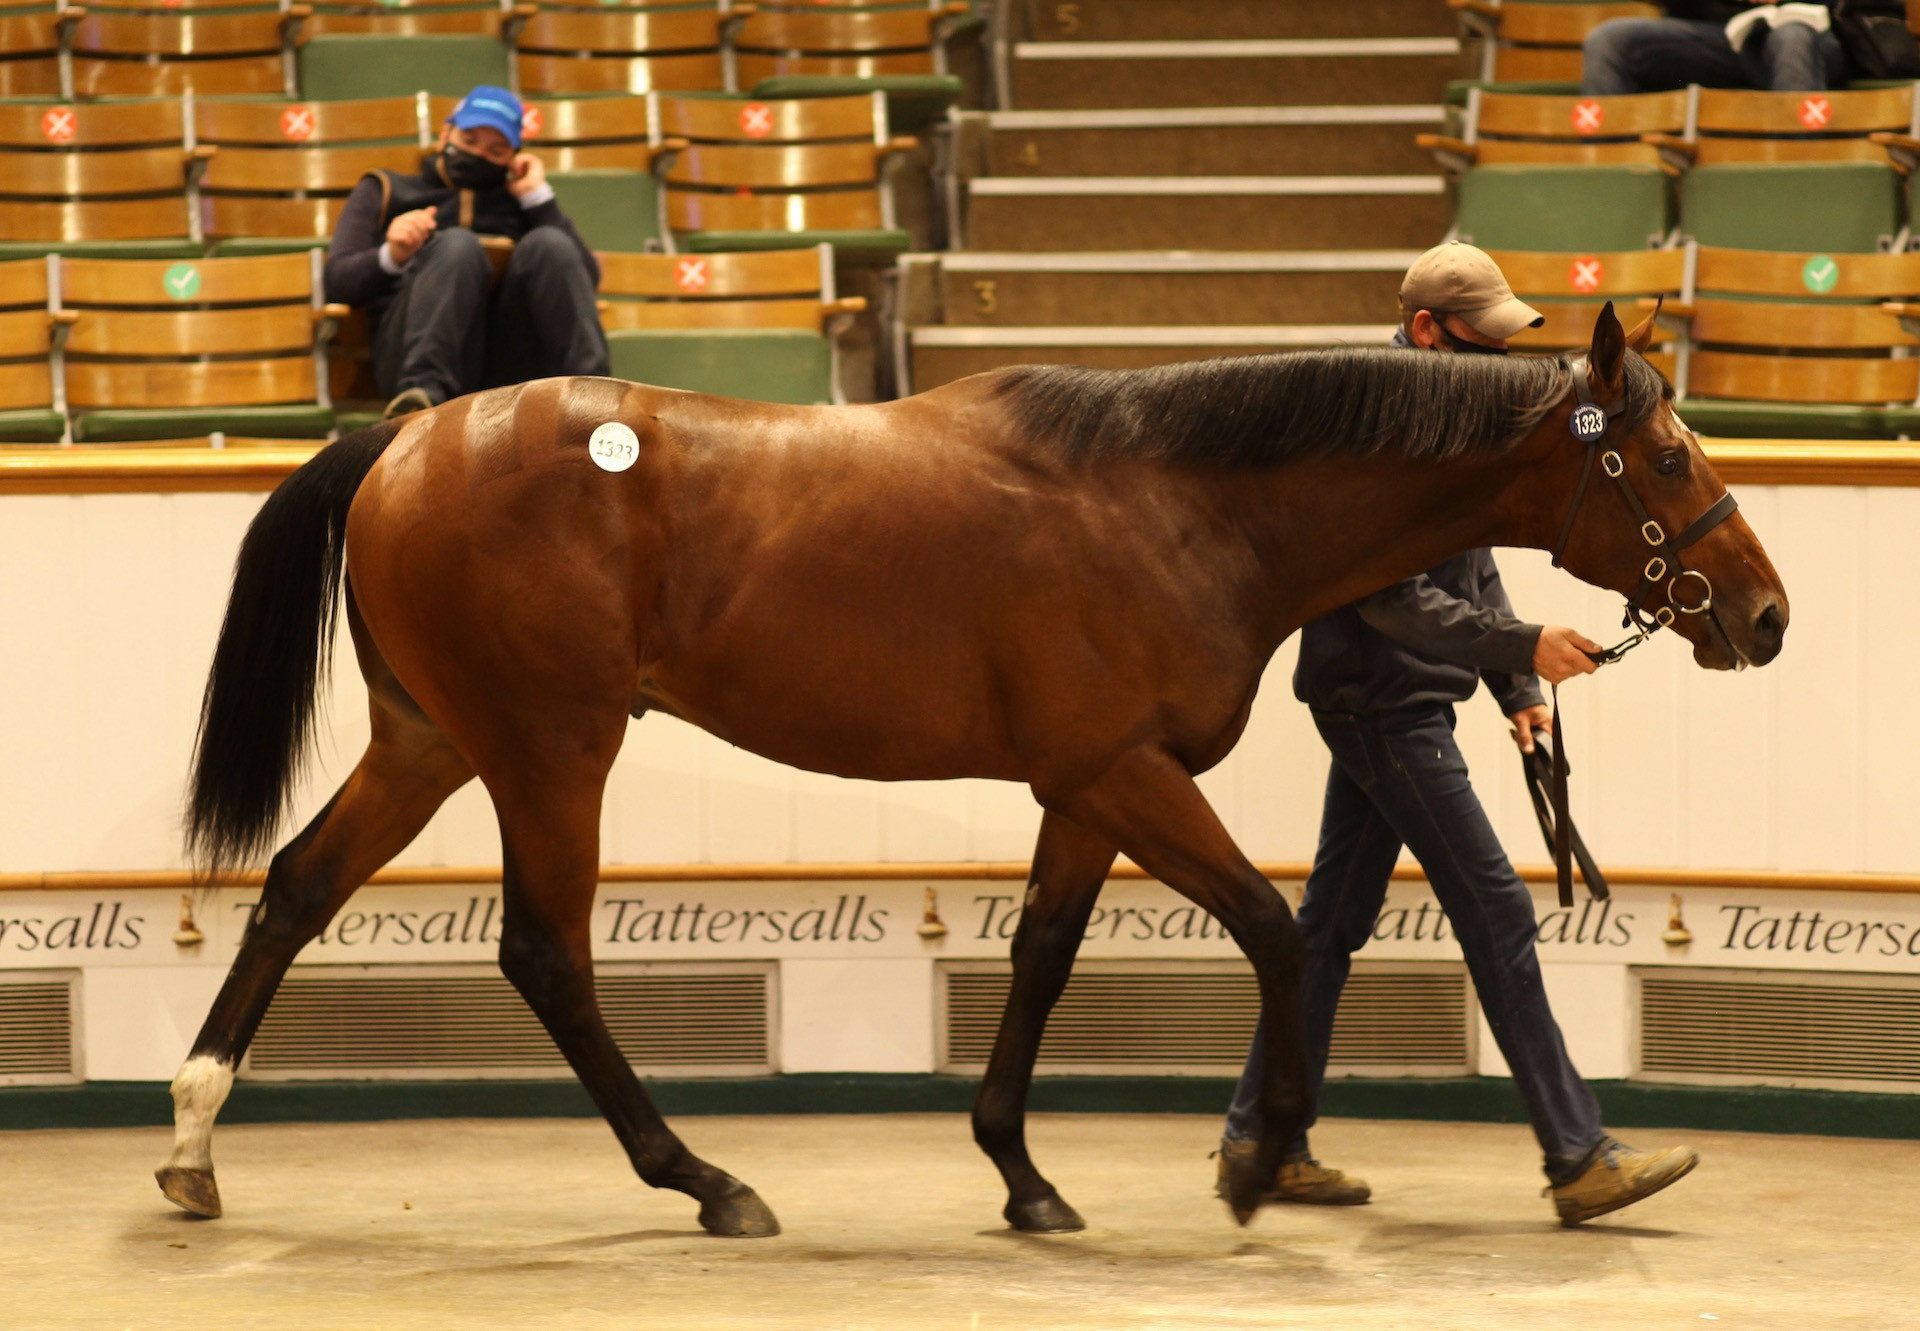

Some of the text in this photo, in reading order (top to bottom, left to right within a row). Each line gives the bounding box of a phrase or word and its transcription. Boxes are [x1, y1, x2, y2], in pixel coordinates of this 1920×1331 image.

[1056, 4, 1080, 34] 5
[973, 280, 997, 313] 3
[1575, 413, 1604, 435] 1323
[596, 439, 633, 461] 1323
[603, 894, 890, 943] Tattersalls
